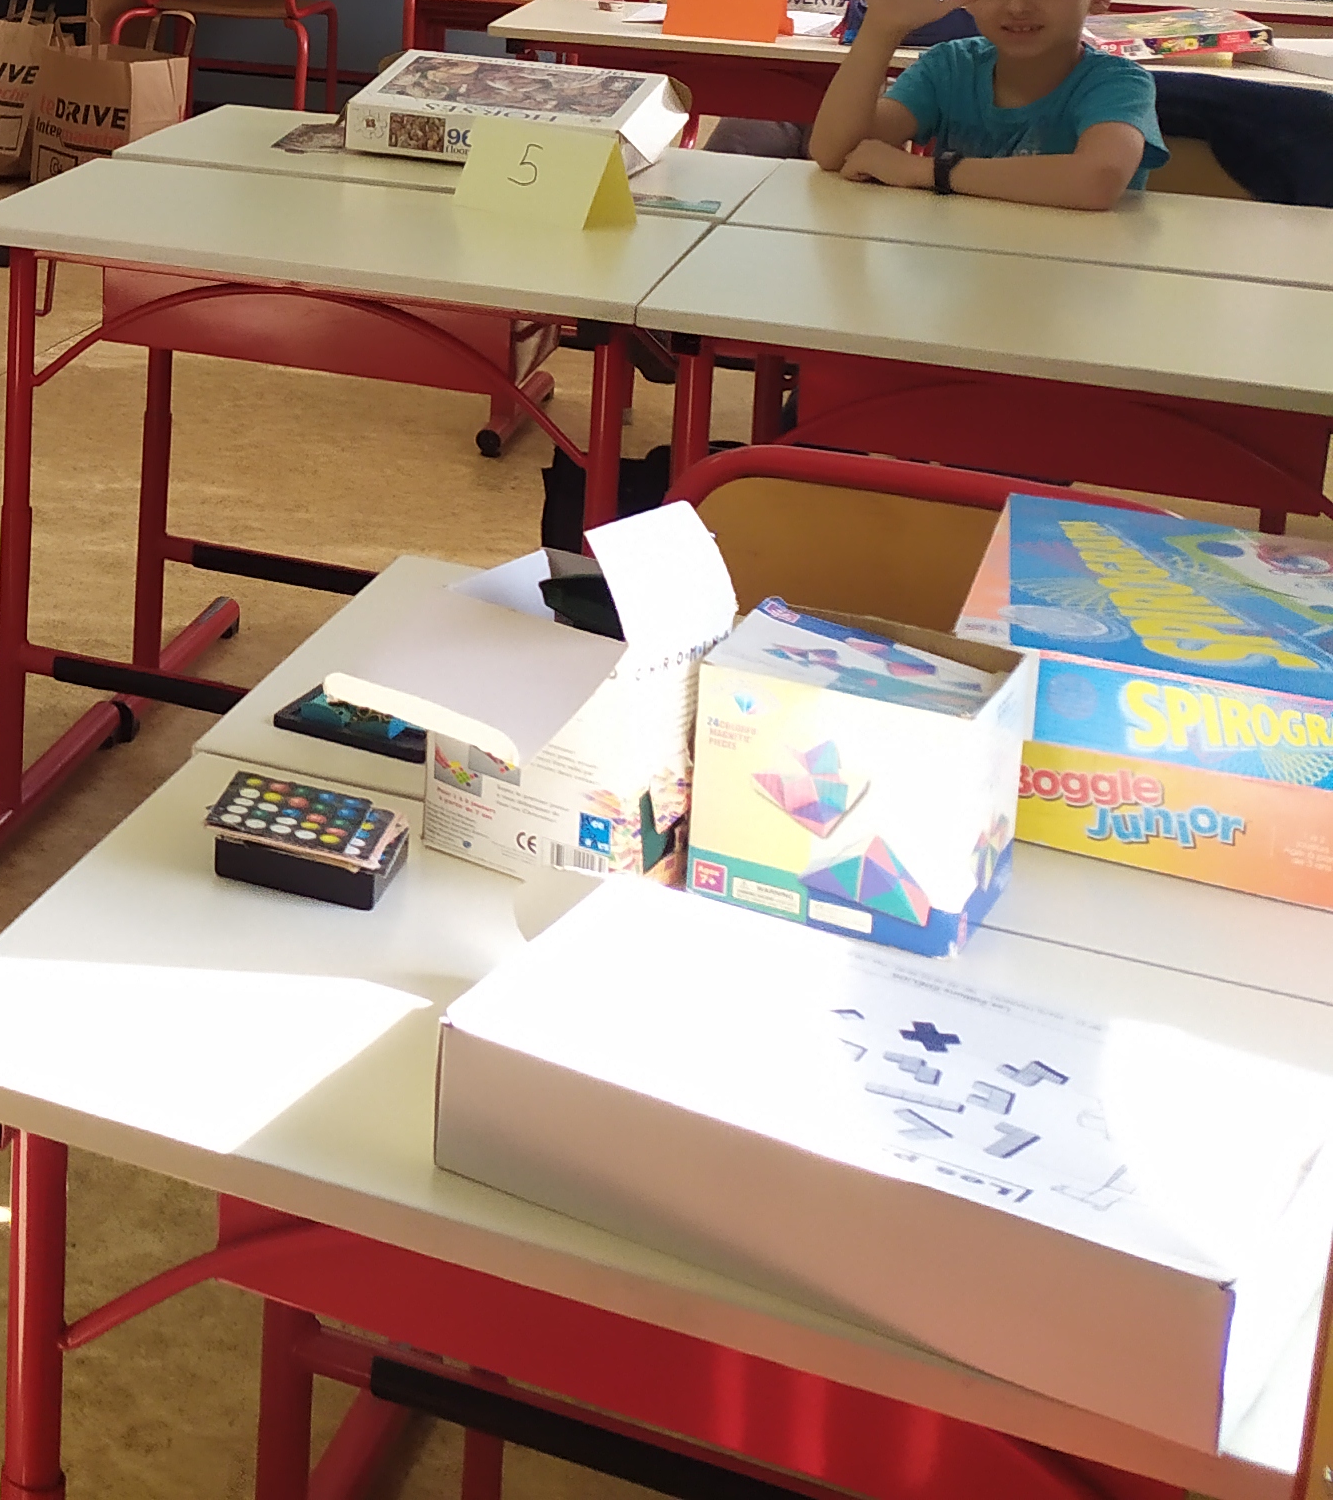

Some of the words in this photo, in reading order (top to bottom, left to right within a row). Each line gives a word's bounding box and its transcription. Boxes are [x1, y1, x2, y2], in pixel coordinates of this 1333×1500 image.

[507, 143, 544, 187] 5
[1123, 681, 1333, 749] SPIROGR
[1087, 805, 1245, 847] Junior
